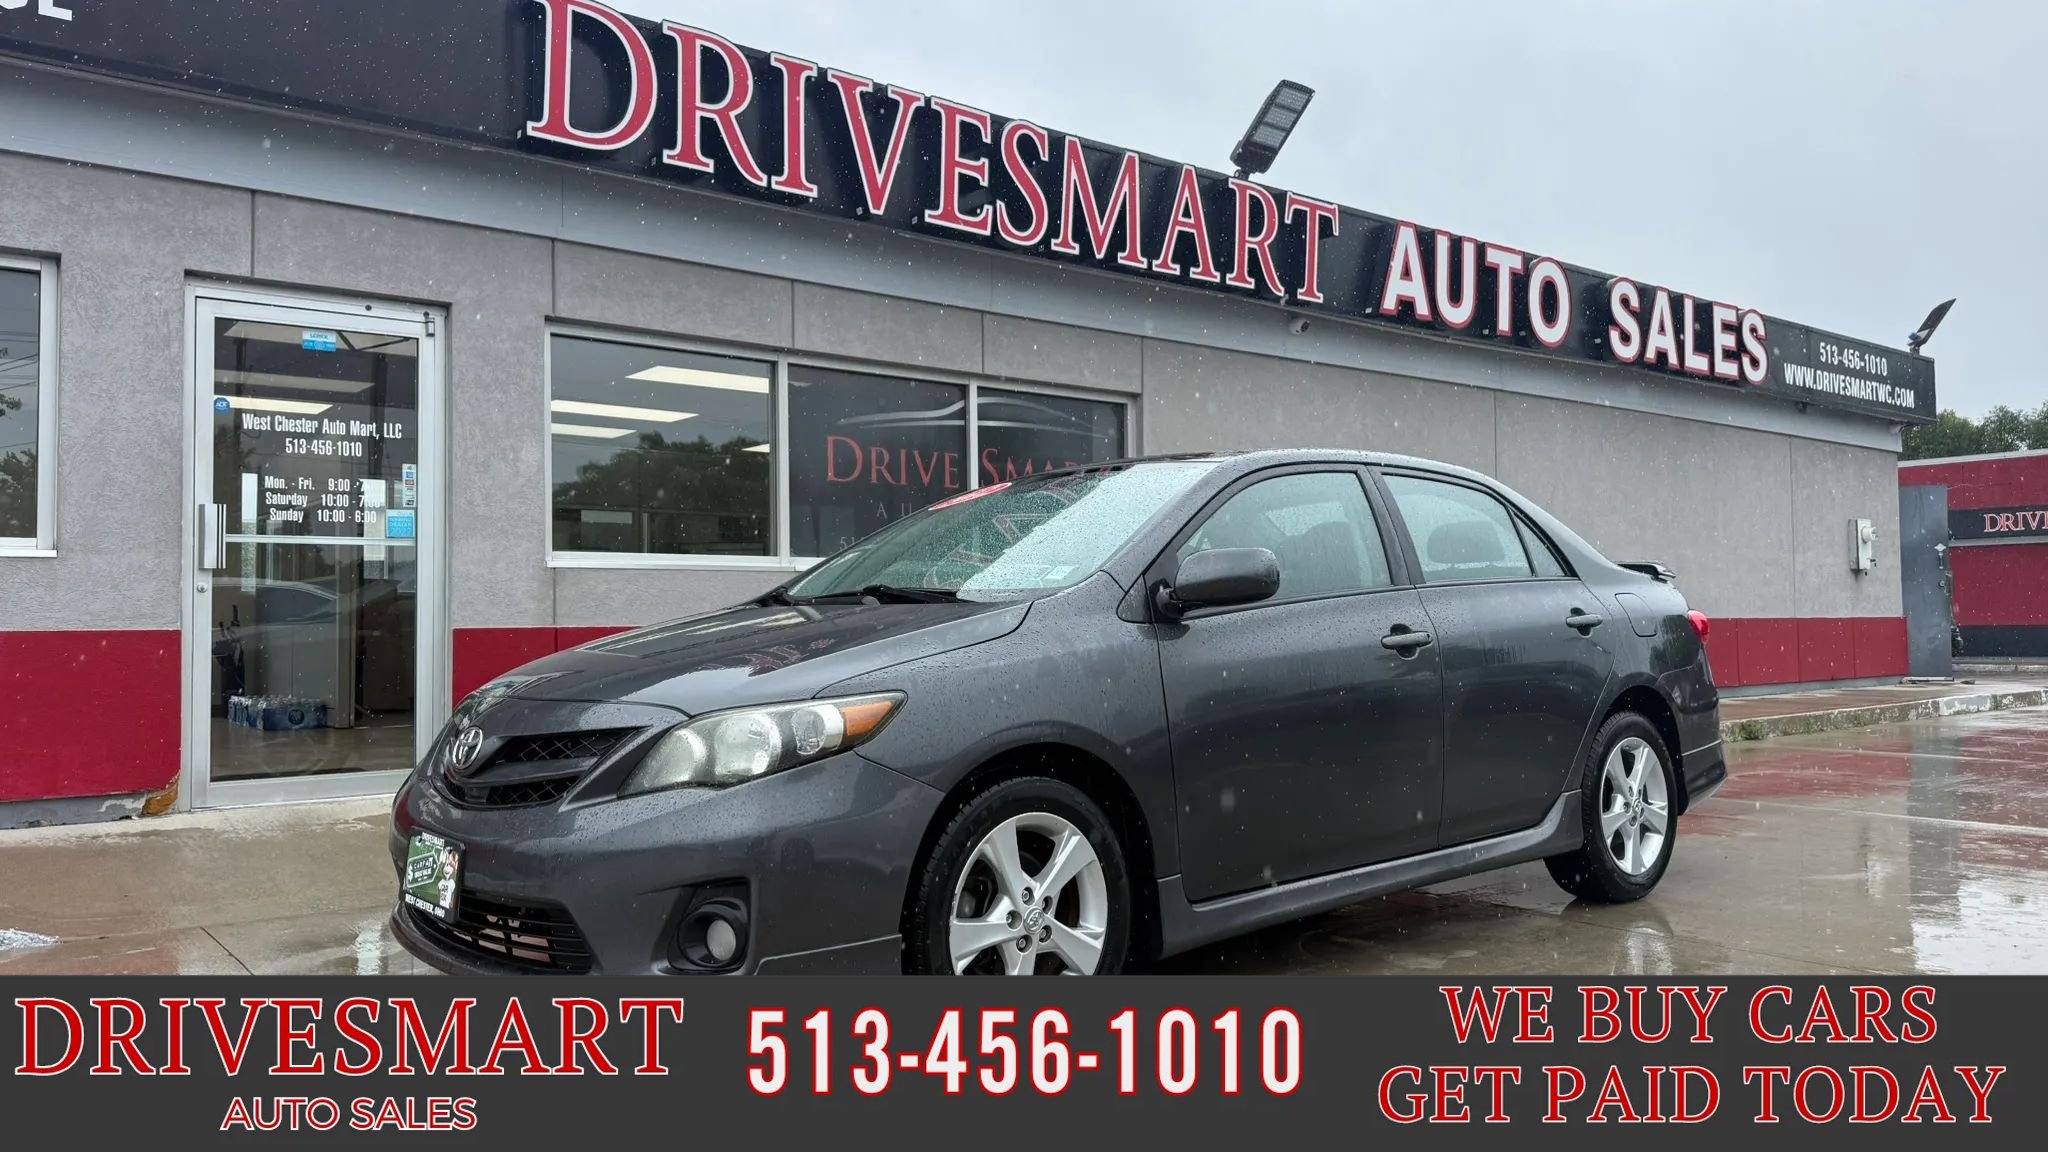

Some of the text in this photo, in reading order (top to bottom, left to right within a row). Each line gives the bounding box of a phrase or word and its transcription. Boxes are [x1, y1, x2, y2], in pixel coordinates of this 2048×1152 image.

[527, 0, 1769, 385] DRIVESMART AUTO SALES
[1820, 342, 1887, 376] 513-456-1010
[1784, 363, 1915, 408] WWW.DRIVESMARTWC.COM
[242, 413, 402, 440] West Chester Auto Mart, LLC
[285, 438, 362, 457] 513-456-1010
[826, 436, 960, 488] DRIVE
[264, 475, 288, 489] Mon.
[298, 477, 315, 490] Fri.
[328, 478, 350, 491] 9:00
[266, 492, 308, 508] Saturday
[321, 494, 349, 507] 10:00
[270, 508, 304, 523] Sunday
[317, 510, 345, 522] 10:00
